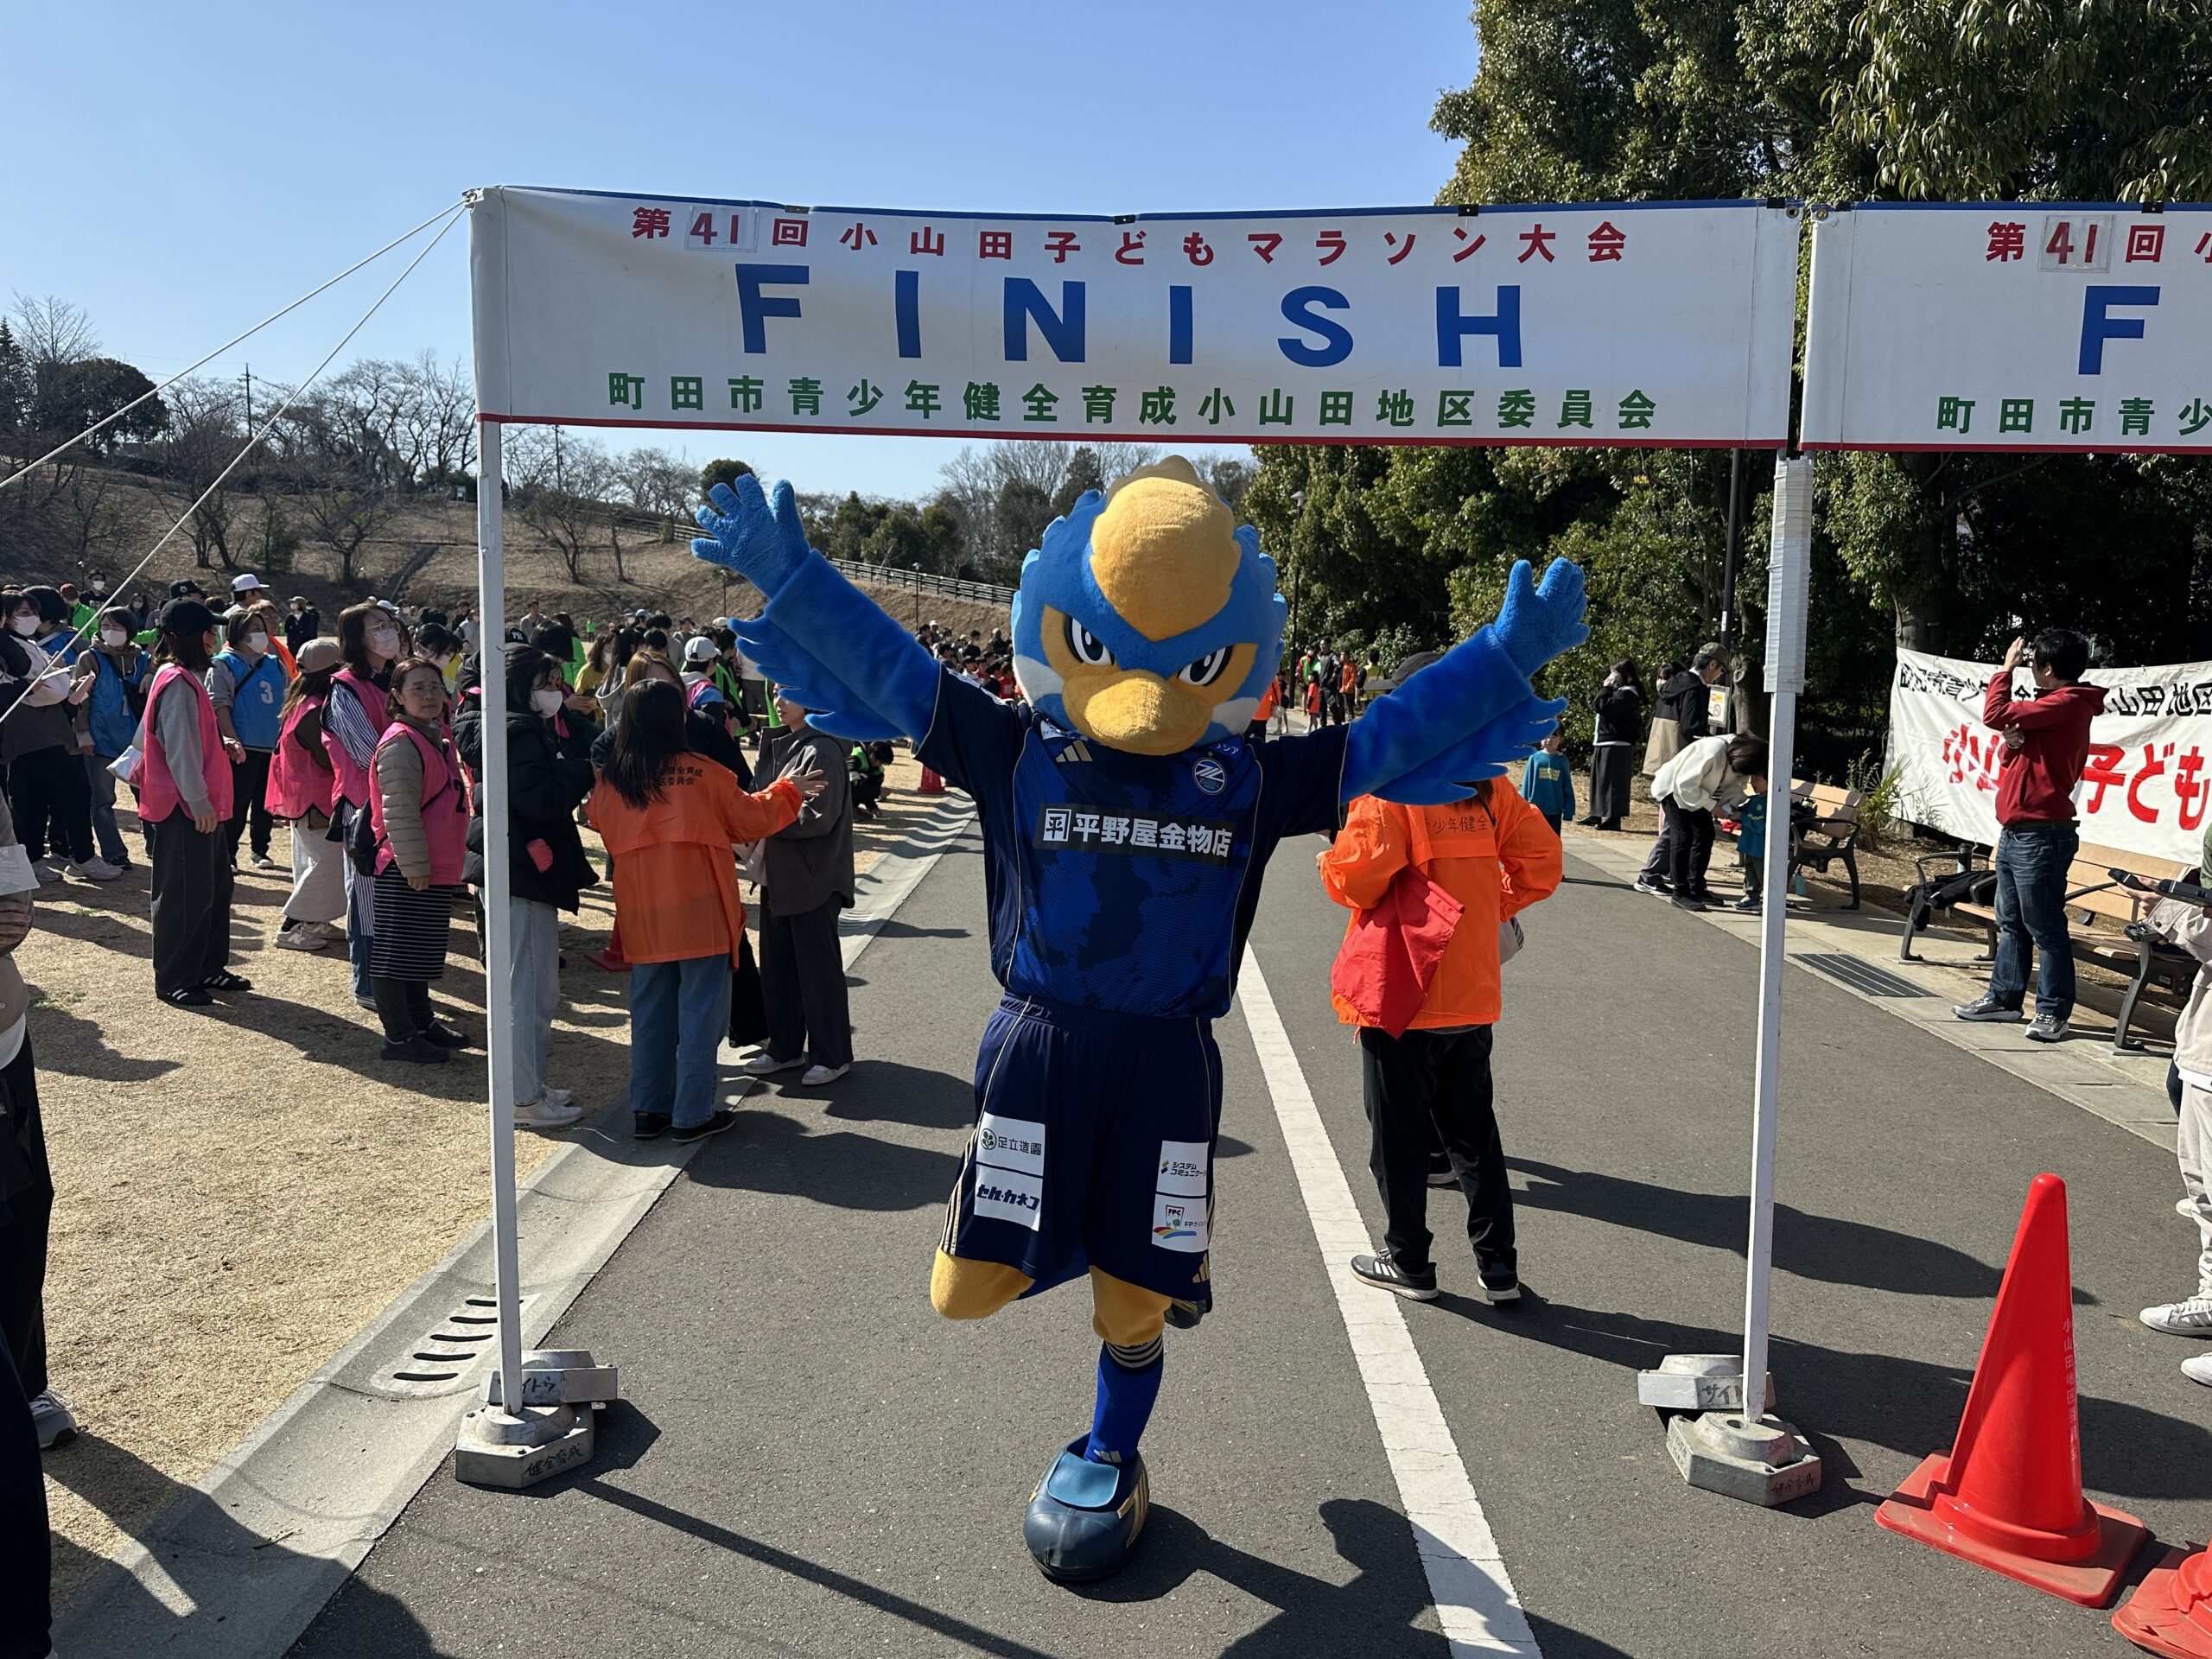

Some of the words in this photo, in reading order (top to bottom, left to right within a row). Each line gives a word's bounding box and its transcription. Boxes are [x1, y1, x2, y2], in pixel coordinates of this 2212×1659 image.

[632, 206, 1626, 266] 第41回小山田子どもマラソン大会
[735, 263, 1522, 367] FINISH
[2078, 285, 2161, 376] F
[608, 372, 1656, 429] 町田市青少年健全育成小山田地区委員会
[259, 680, 274, 704] 3
[1073, 812, 1233, 858] 平野屋金物店
[998, 1136, 1042, 1156] 足立造園
